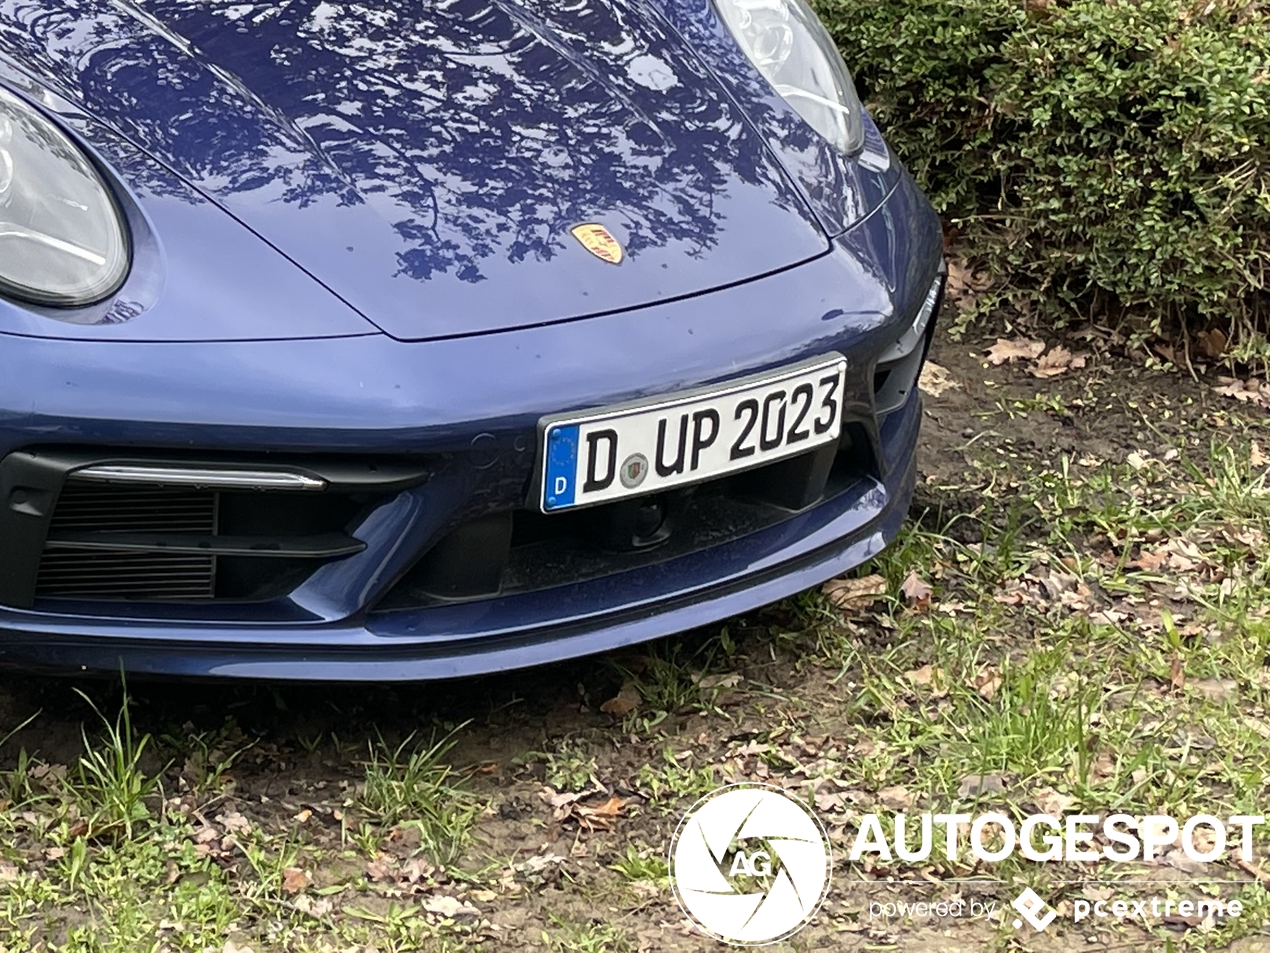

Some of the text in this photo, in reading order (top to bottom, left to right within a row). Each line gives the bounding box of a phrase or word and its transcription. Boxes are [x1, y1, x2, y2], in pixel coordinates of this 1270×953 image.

[583, 373, 840, 493] D UP 2023
[554, 477, 567, 495] D
